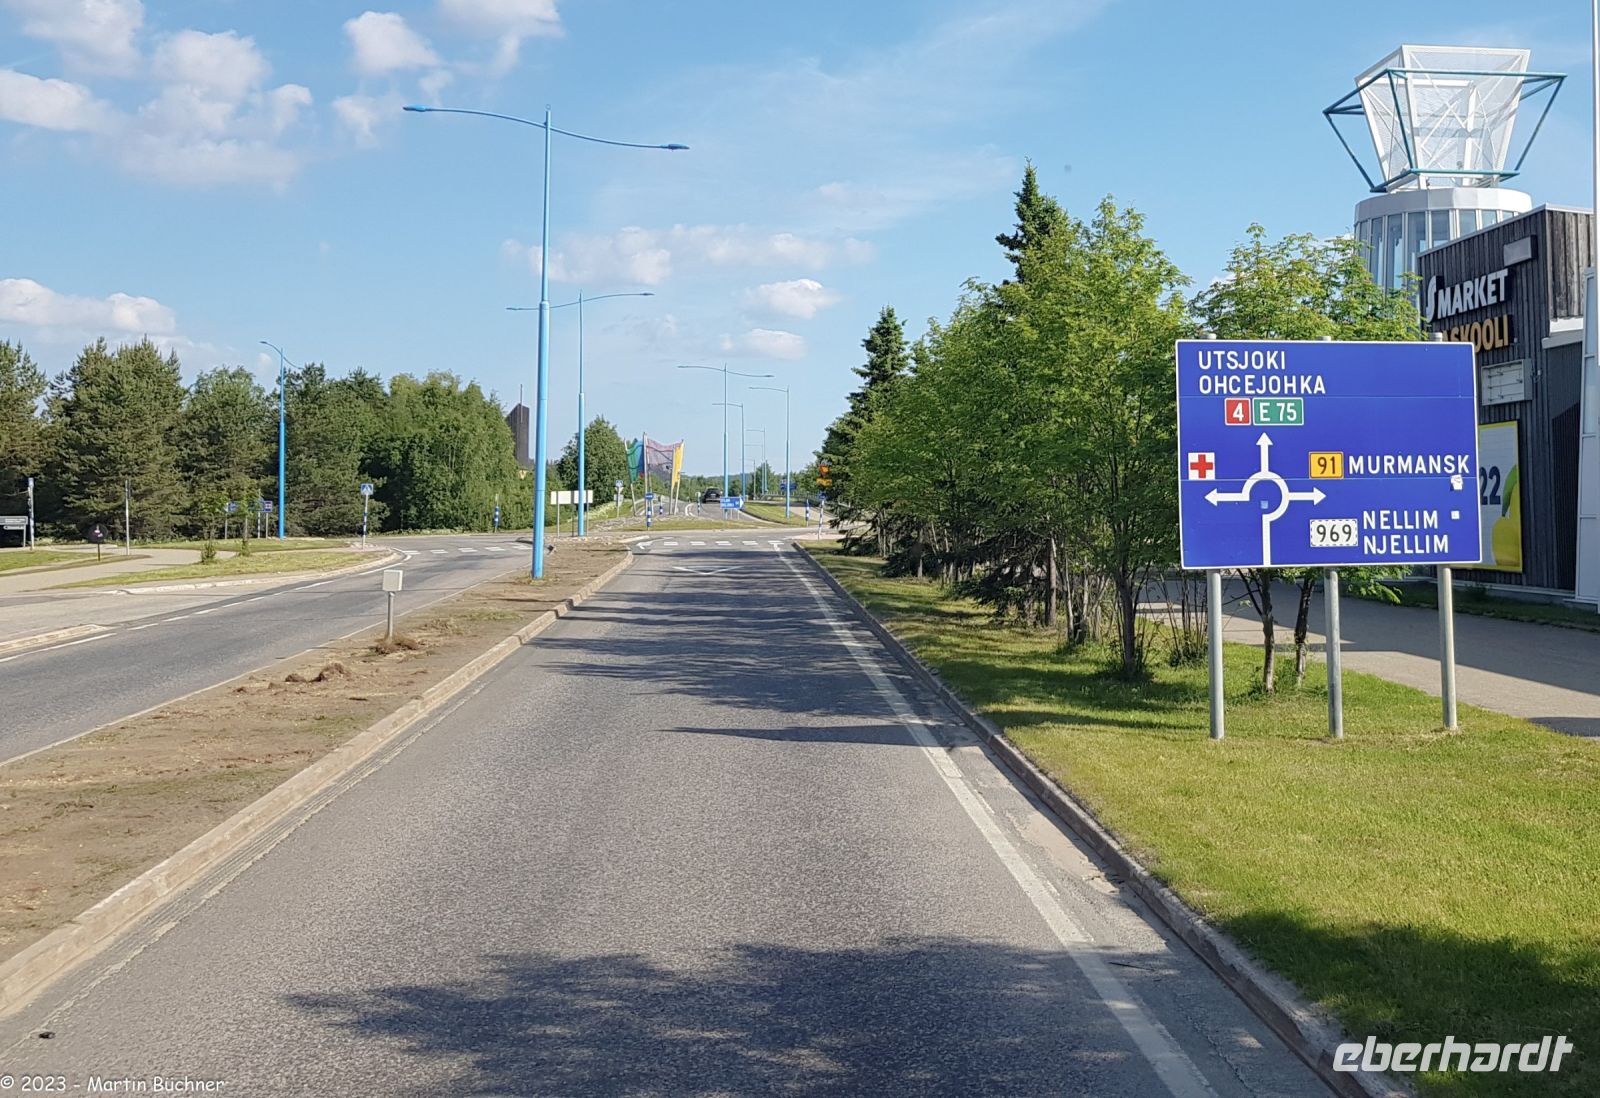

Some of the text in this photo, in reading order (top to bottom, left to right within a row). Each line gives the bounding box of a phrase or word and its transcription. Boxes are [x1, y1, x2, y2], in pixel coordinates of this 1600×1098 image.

[1199, 351, 1285, 369] UTSJOKI
[1200, 375, 1325, 394] OHCEJOHKA
[1233, 403, 1244, 421] 4
[1260, 403, 1296, 421] E 75
[1318, 455, 1469, 474] 91 MURMANSK
[1364, 511, 1437, 529] NELLIM
[1317, 525, 1351, 542] 969
[1364, 535, 1448, 554] NJELLIM
